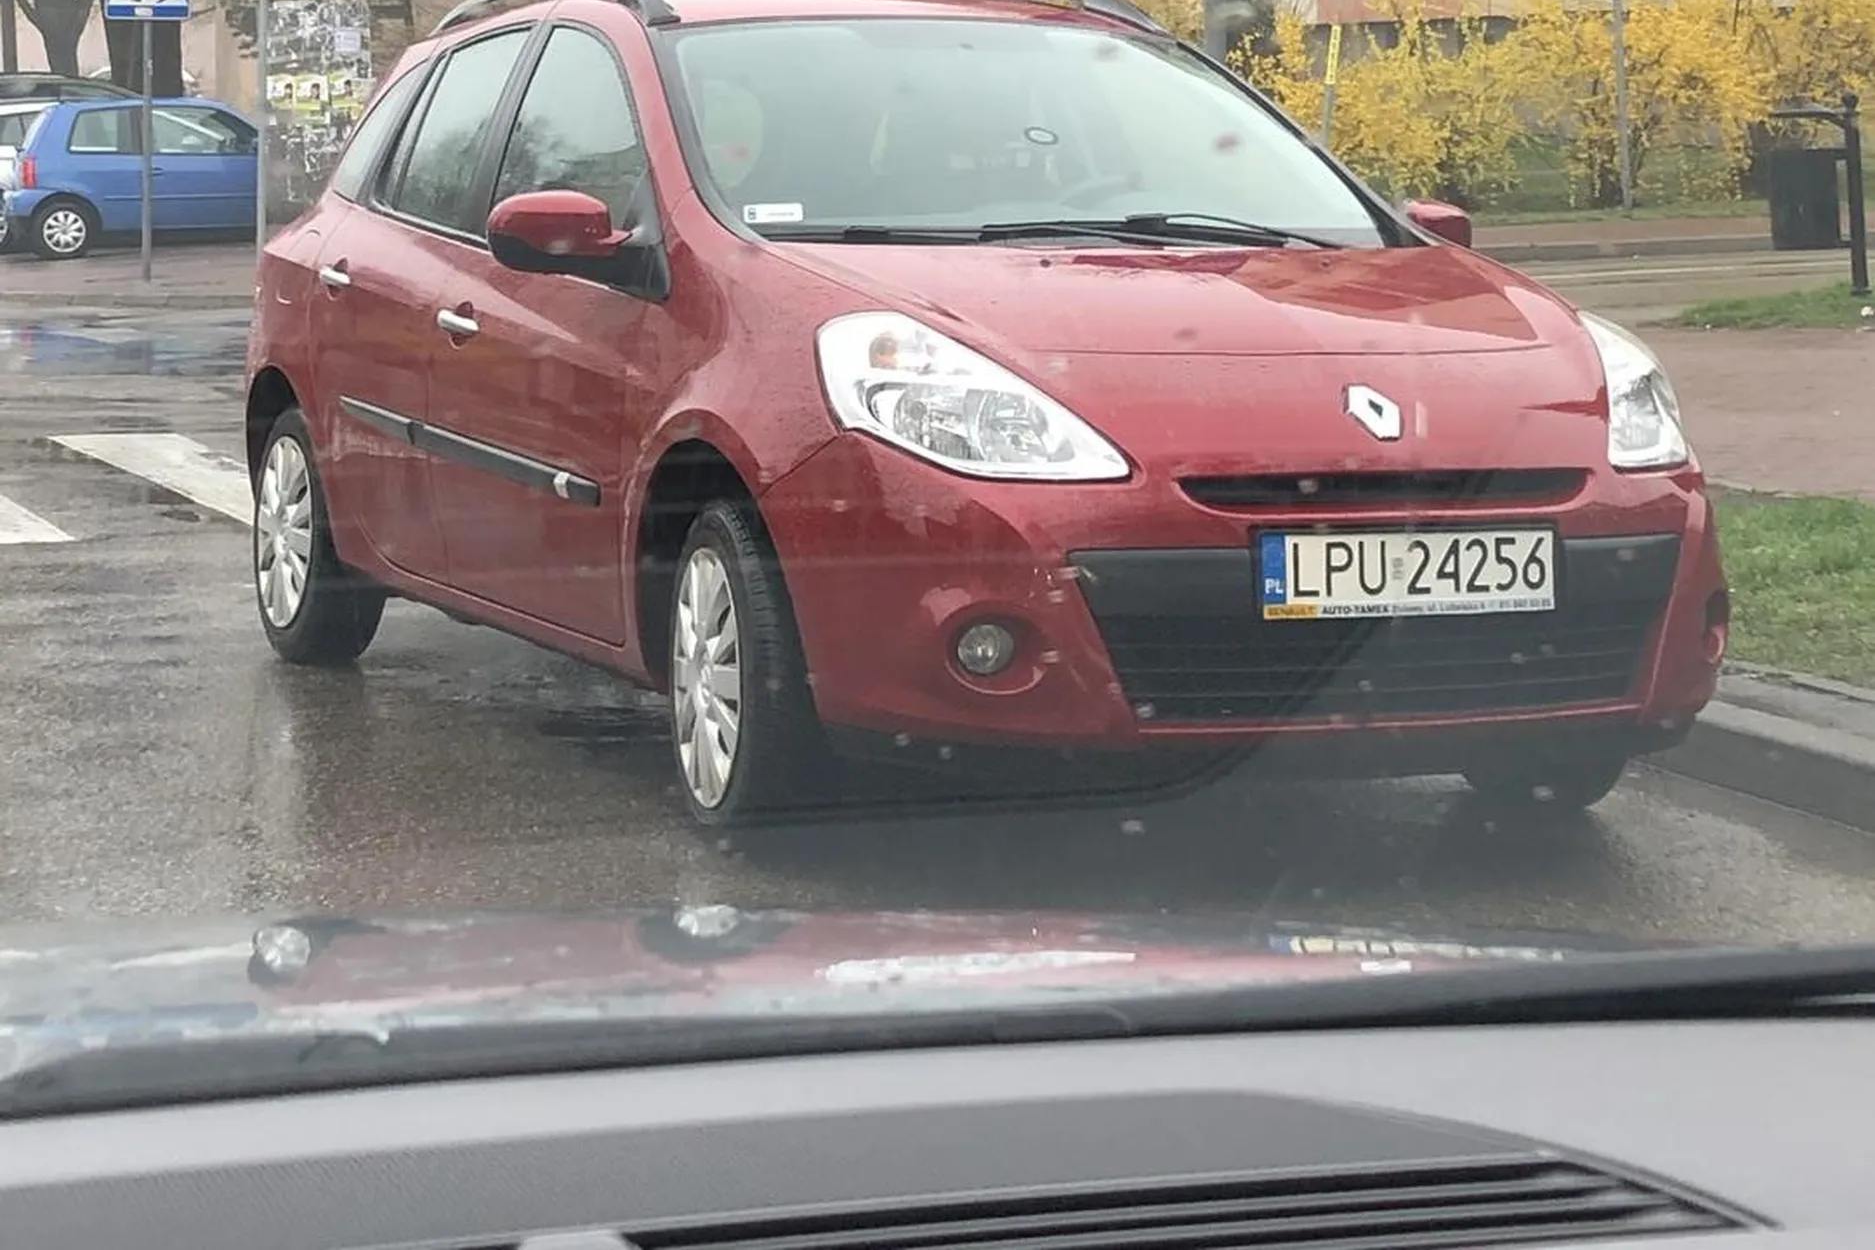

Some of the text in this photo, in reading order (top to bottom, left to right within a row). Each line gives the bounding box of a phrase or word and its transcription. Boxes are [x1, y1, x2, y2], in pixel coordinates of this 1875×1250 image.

[1265, 578, 1284, 594] PL
[1292, 537, 1546, 597] LPU 24256
